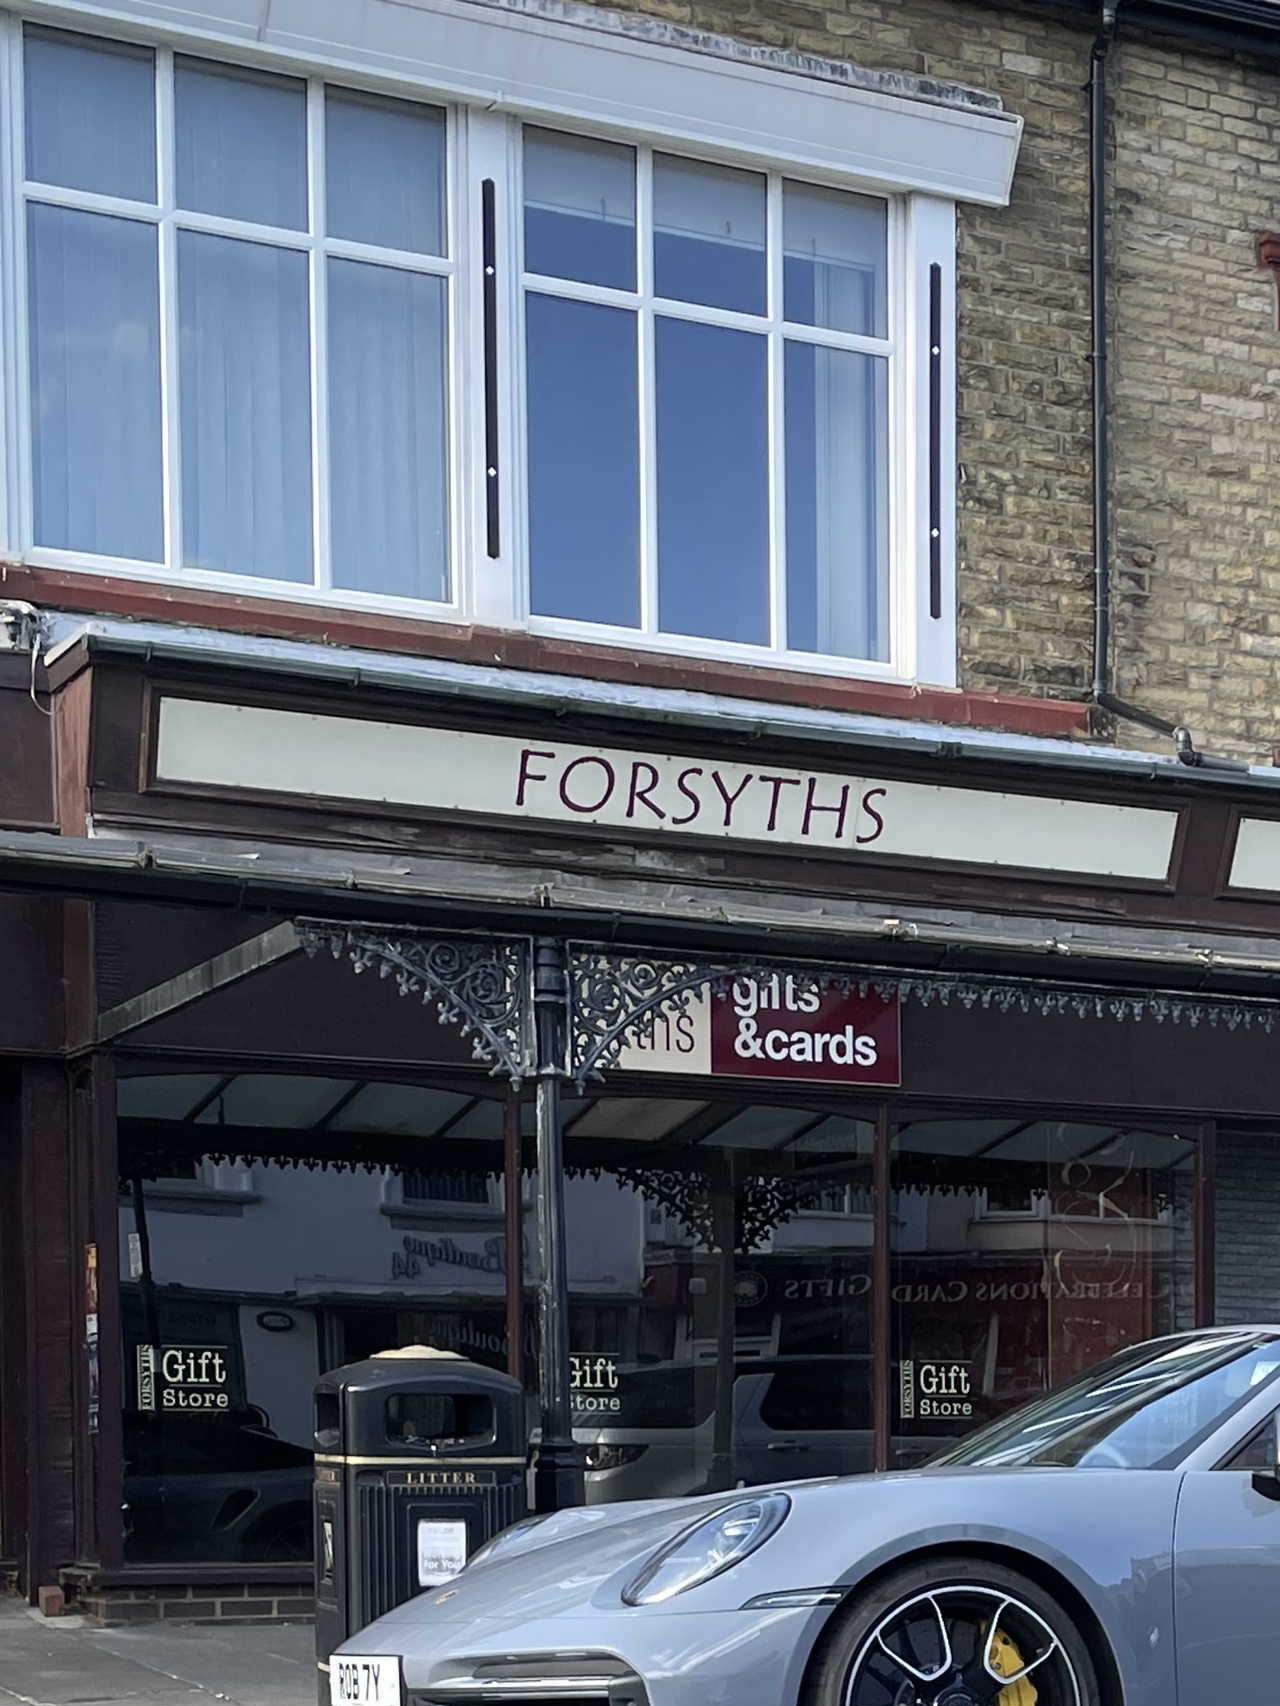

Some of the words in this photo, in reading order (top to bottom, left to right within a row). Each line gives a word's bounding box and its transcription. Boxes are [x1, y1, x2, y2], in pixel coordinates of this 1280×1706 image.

[516, 749, 886, 844] FORSYTHS
[733, 1017, 878, 1067] &cards
[162, 1350, 227, 1382] Gift
[920, 1365, 971, 1394] Gift
[163, 1388, 229, 1407] Store
[570, 1394, 621, 1410] tore
[920, 1399, 972, 1415] Store
[406, 1472, 477, 1484] LITTER
[424, 1559, 439, 1569] for
[362, 1663, 381, 1701] 7Y
